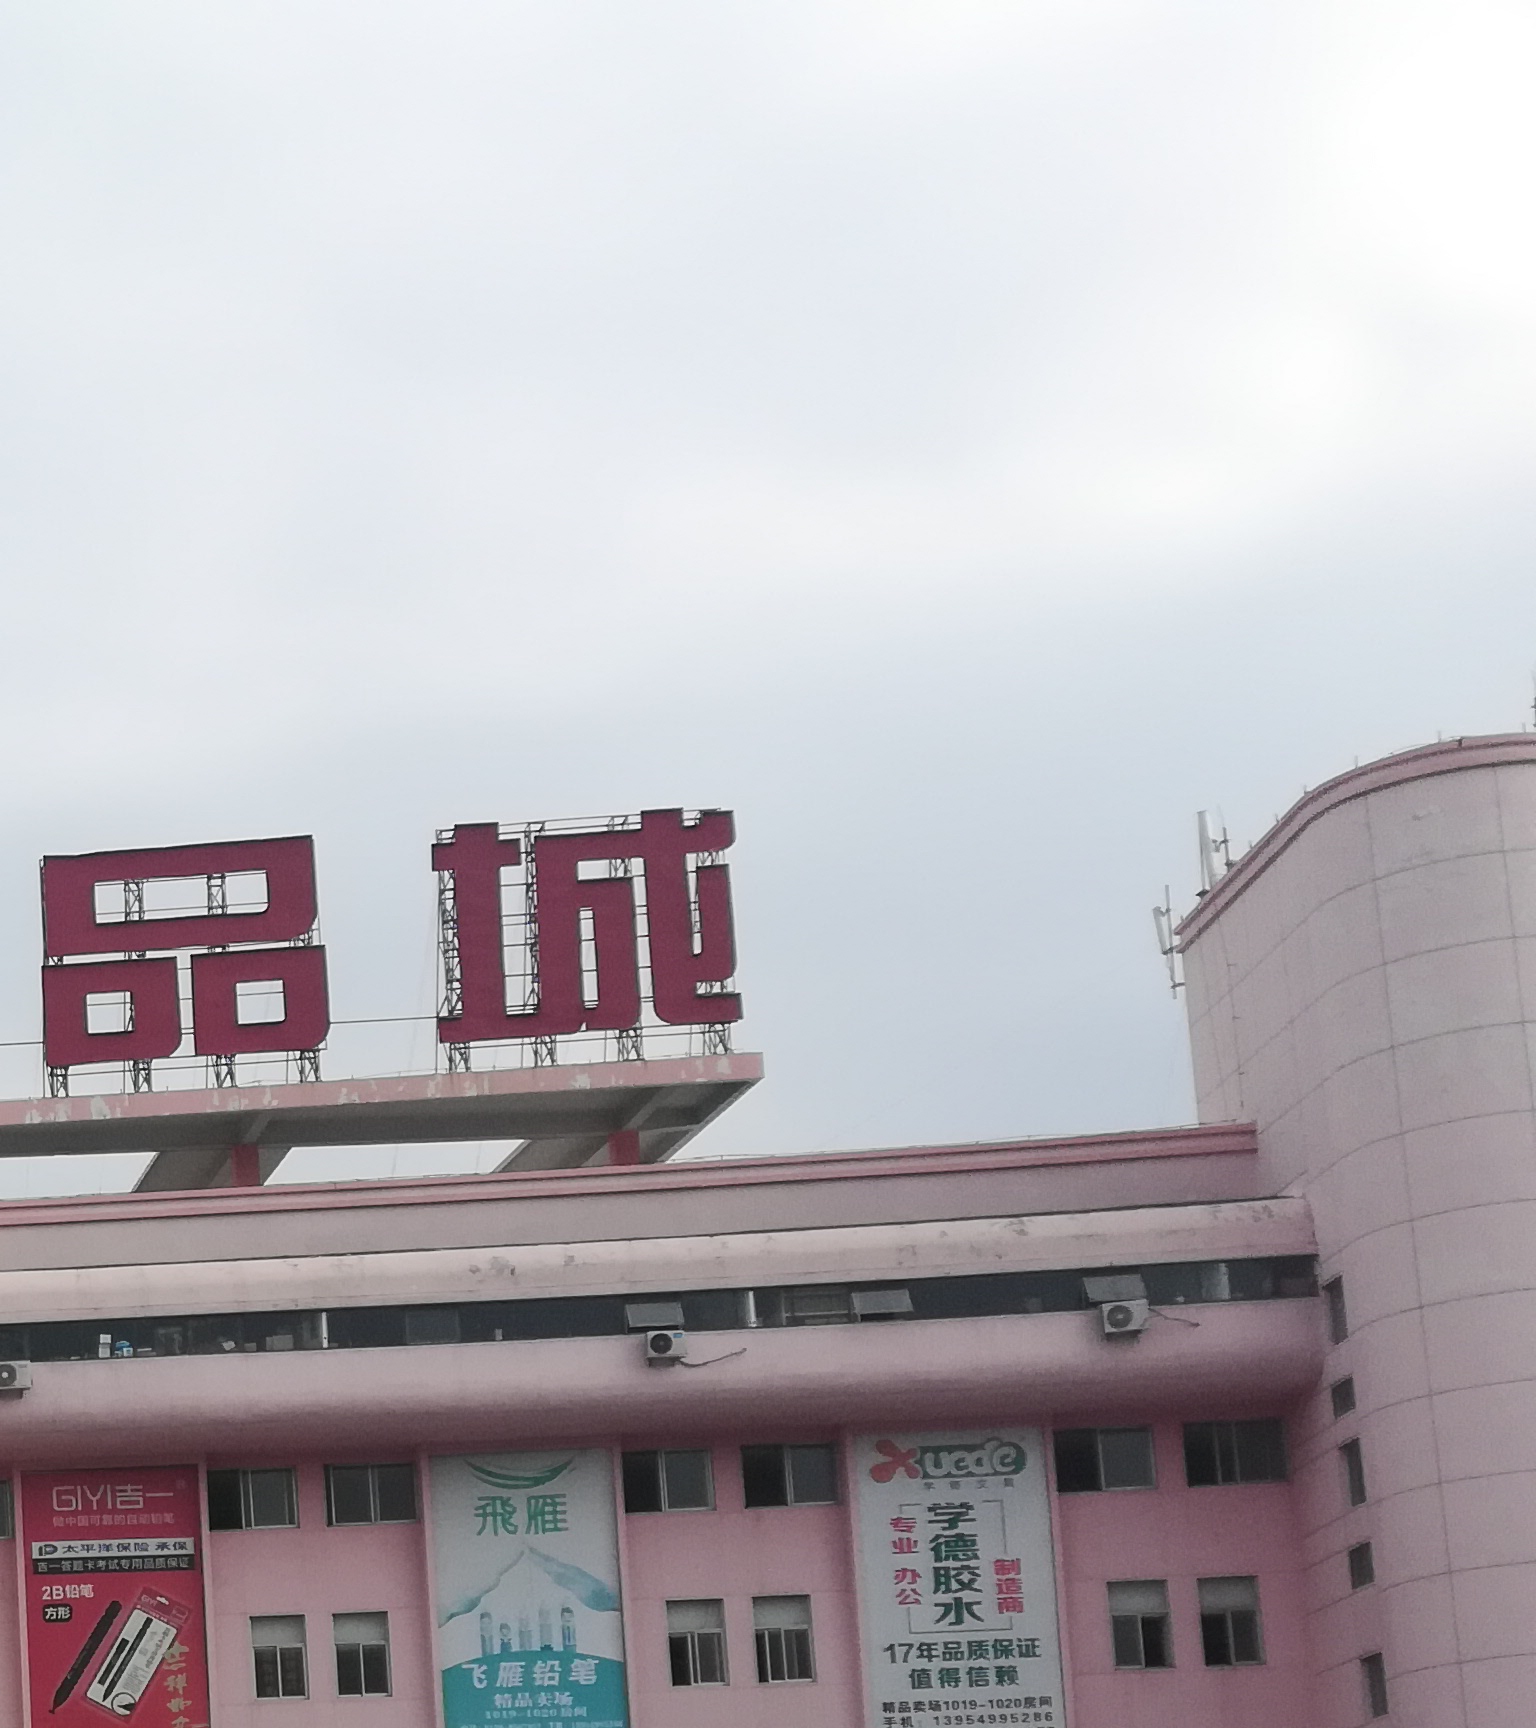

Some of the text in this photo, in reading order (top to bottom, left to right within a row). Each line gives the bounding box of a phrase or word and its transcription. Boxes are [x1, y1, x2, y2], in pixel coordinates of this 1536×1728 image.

[473, 1493, 569, 1536] 飛雁
[61, 1541, 189, 1554] 太平洋保险 承保
[927, 1502, 984, 1626] 学德胶水
[42, 1584, 94, 1600] 2B铅笔
[993, 1557, 1024, 1615] 制造商
[44, 1607, 72, 1620] 方形
[883, 1637, 1042, 1664] 17年品质保证
[461, 1659, 599, 1689] 飞雁铅笔
[909, 1665, 1020, 1690] 值得信赖
[494, 1692, 573, 1708] 精品卖场
[882, 1696, 1053, 1713] 精品卖场1019-1020房间
[933, 1712, 1053, 1726] 13954995286
